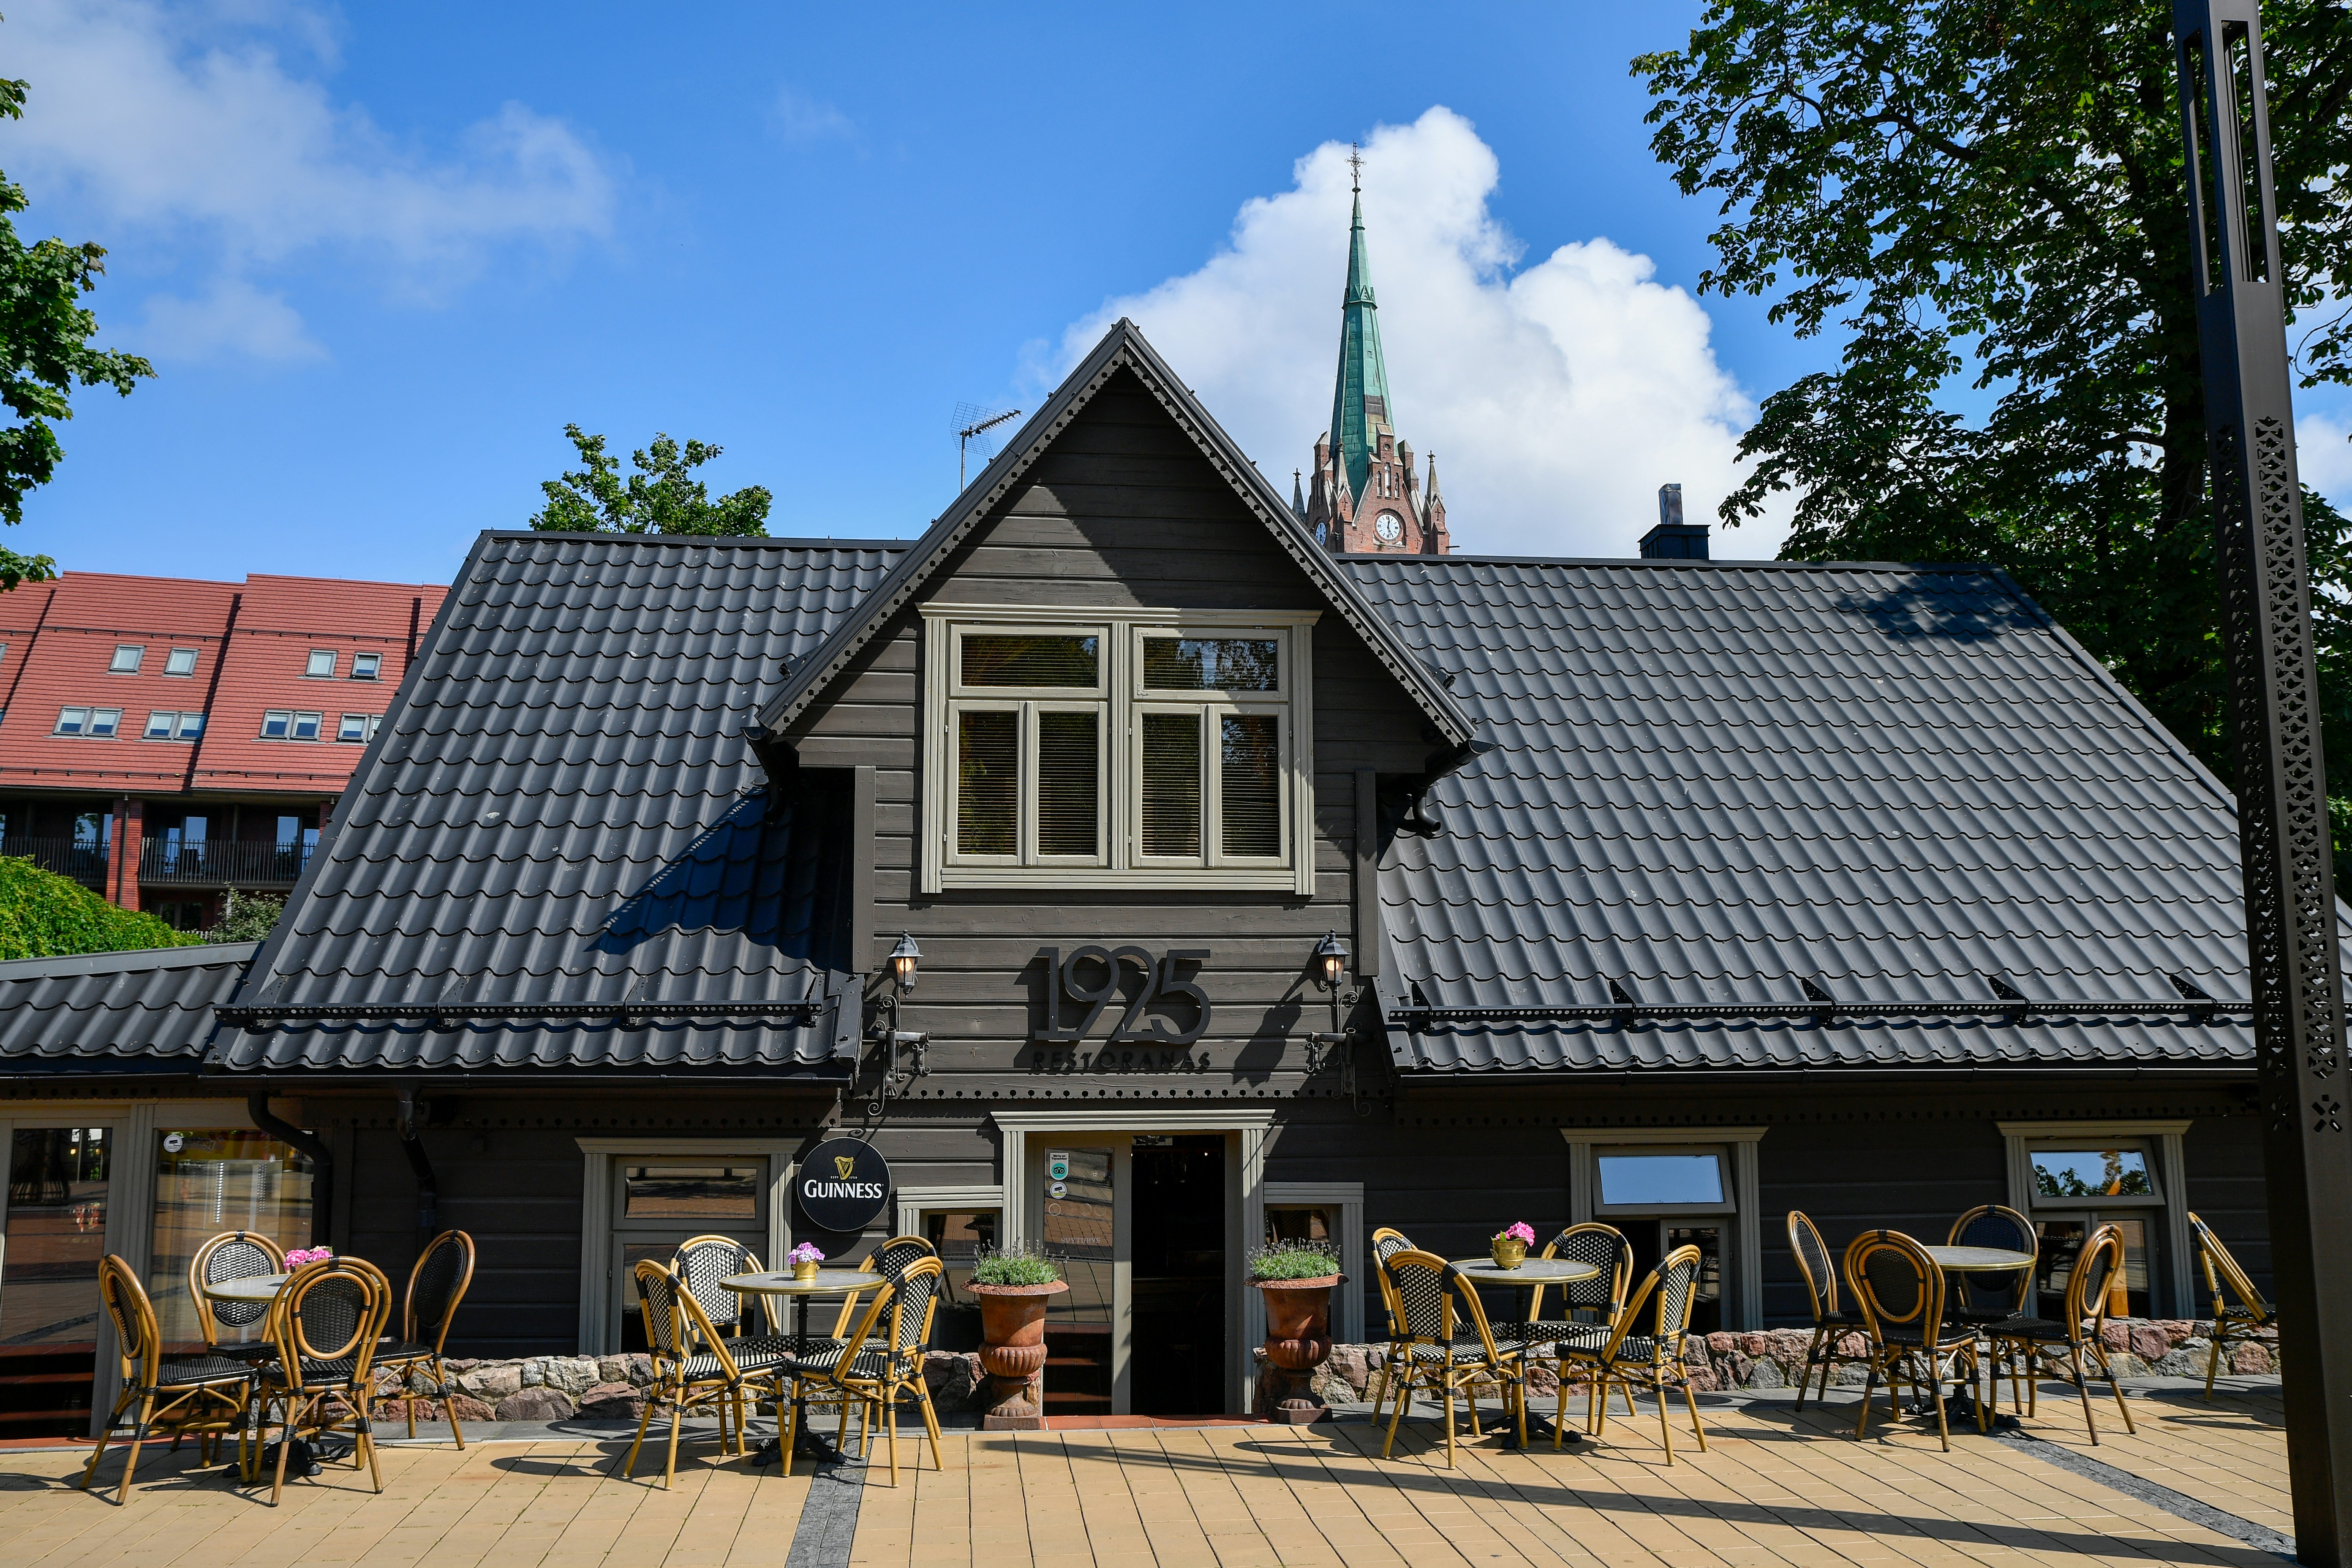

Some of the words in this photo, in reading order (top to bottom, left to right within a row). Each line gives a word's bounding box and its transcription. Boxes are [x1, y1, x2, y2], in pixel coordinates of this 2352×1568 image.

[1034, 945, 1211, 1045] 1925
[1034, 1051, 1211, 1068] RESTORANAS
[804, 1179, 882, 1198] GUINNESS
